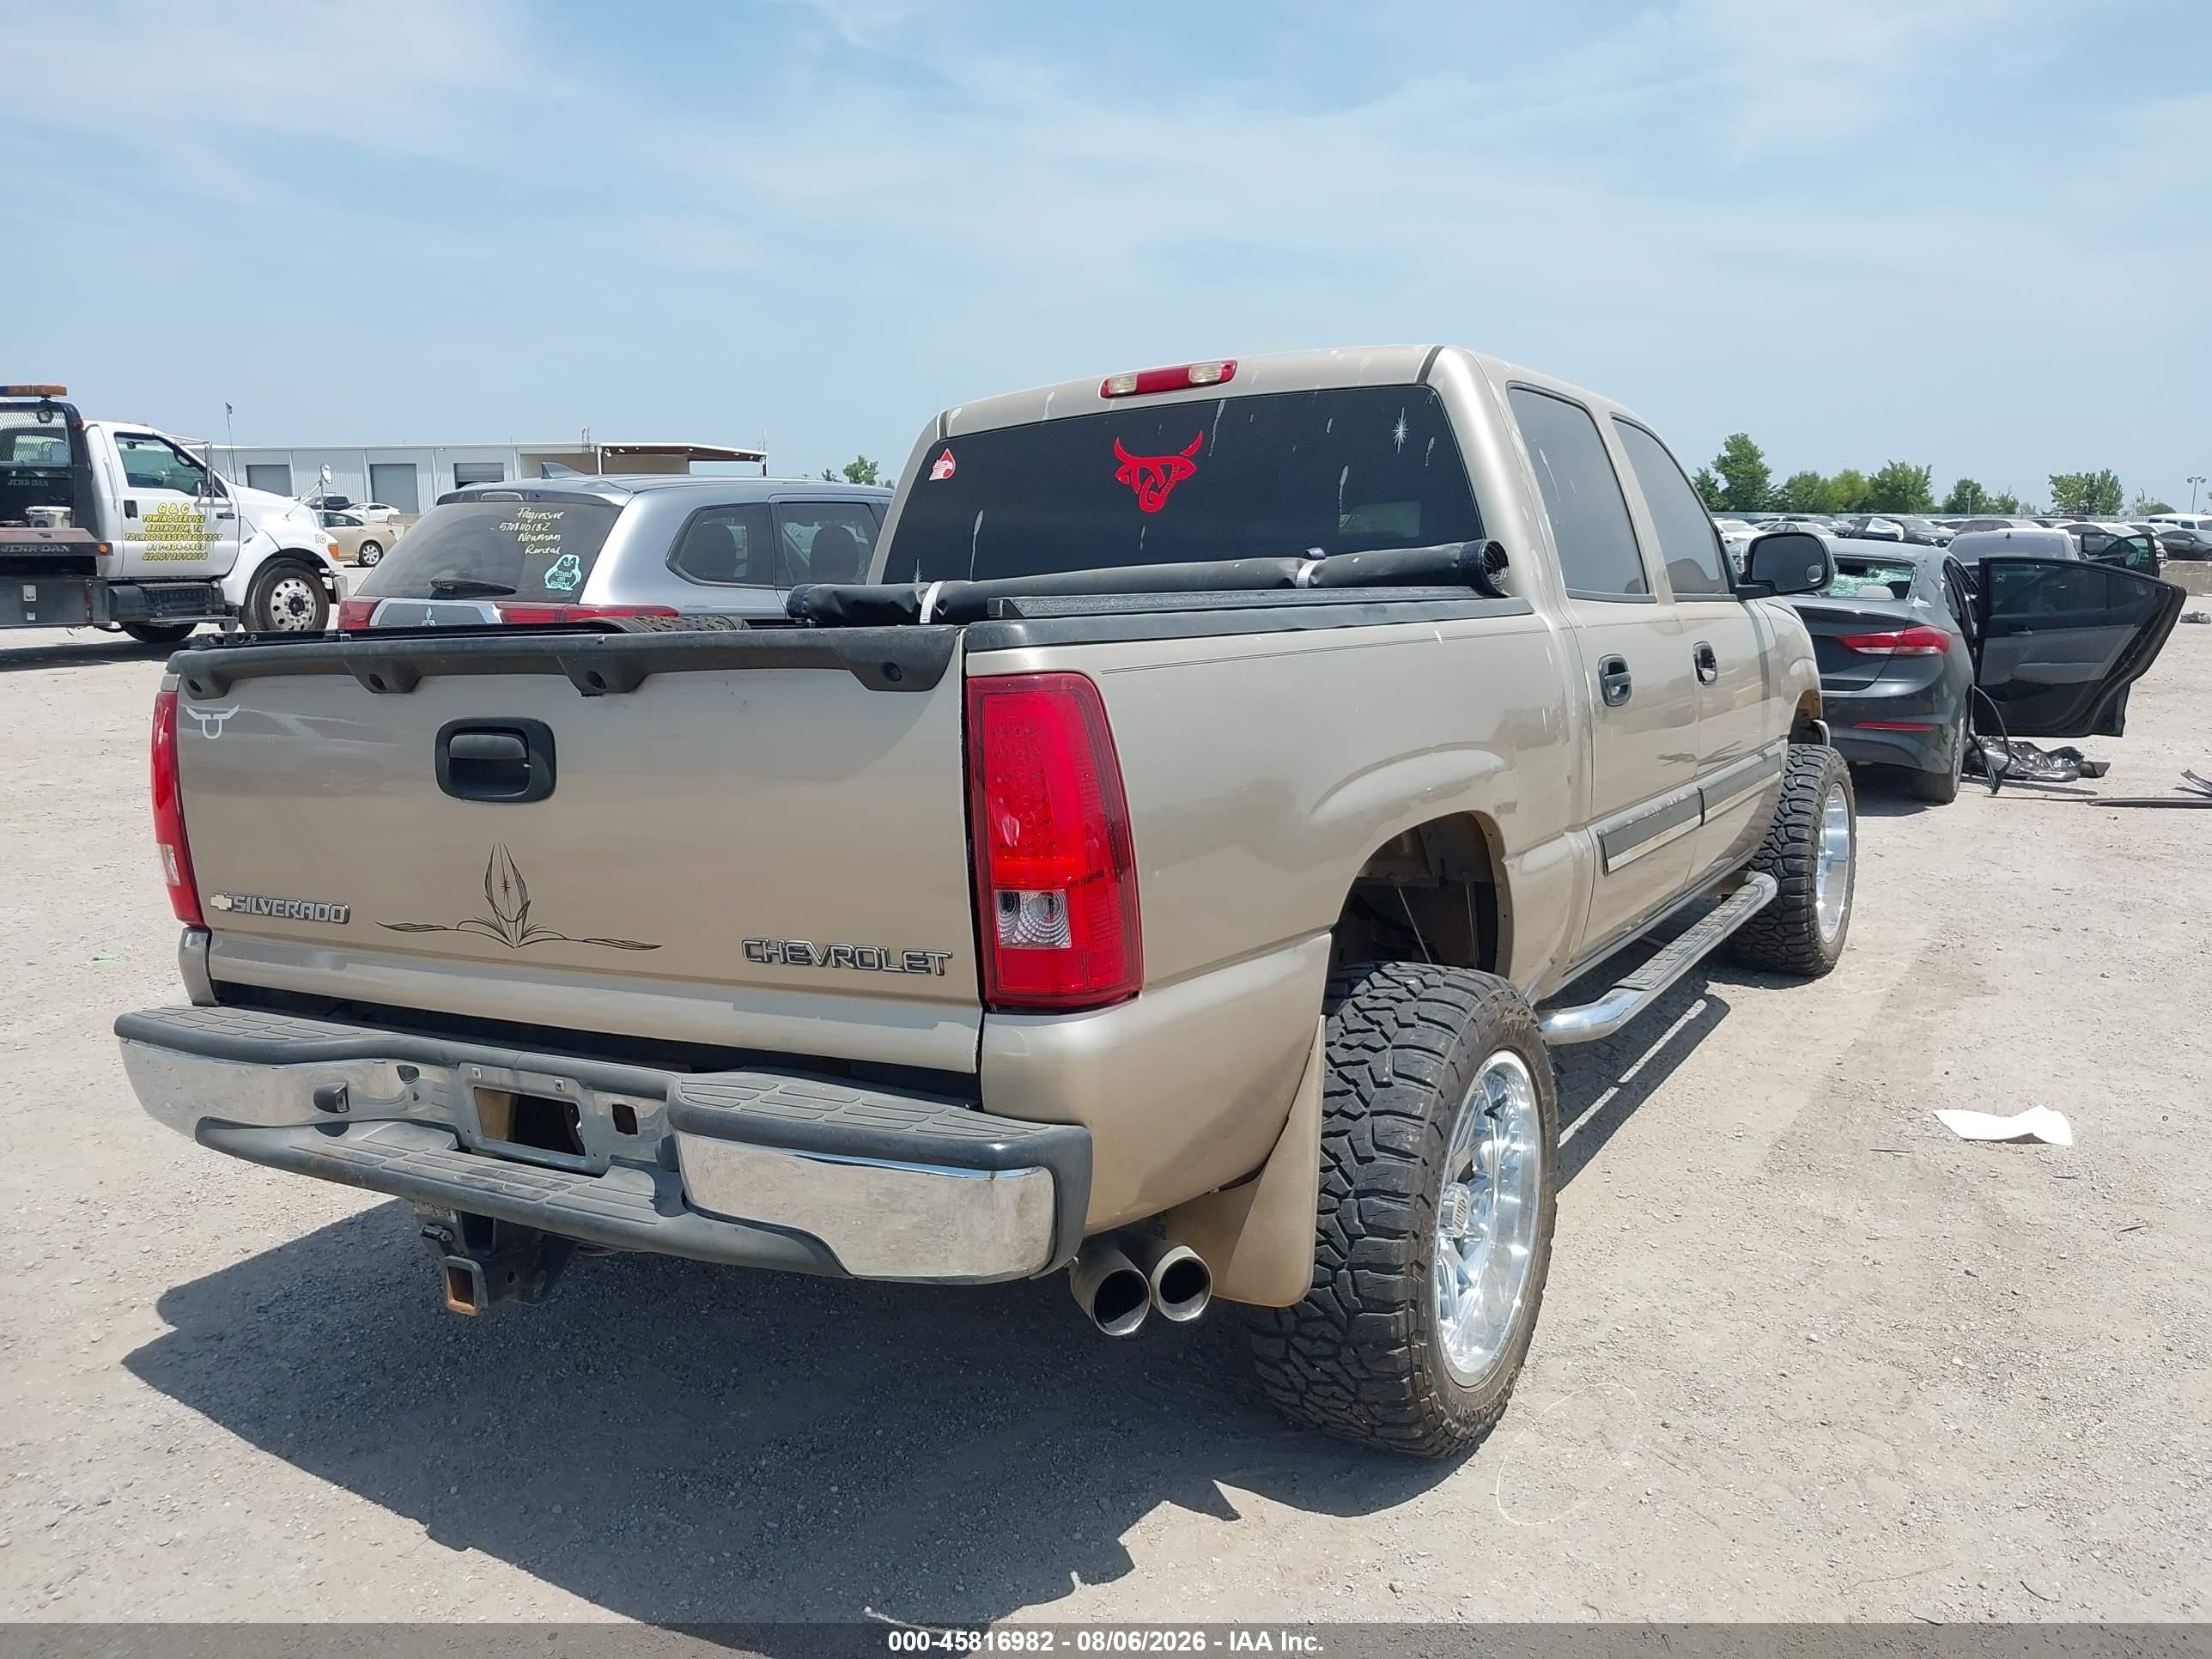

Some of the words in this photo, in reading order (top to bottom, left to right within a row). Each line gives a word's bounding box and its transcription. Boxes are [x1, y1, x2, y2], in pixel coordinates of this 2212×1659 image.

[158, 502, 167, 514] G
[168, 503, 179, 514] &
[181, 502, 190, 514] C
[143, 514, 172, 523] TOWING
[173, 514, 206, 523] SERVICE
[516, 507, 564, 523] Progressive
[145, 524, 191, 533] ARLINGTON,
[314, 534, 326, 544] 10
[518, 532, 561, 542] Newman
[525, 544, 561, 555] Rental
[233, 896, 350, 925] SILVERADO
[741, 937, 952, 976] CHEVROLET
